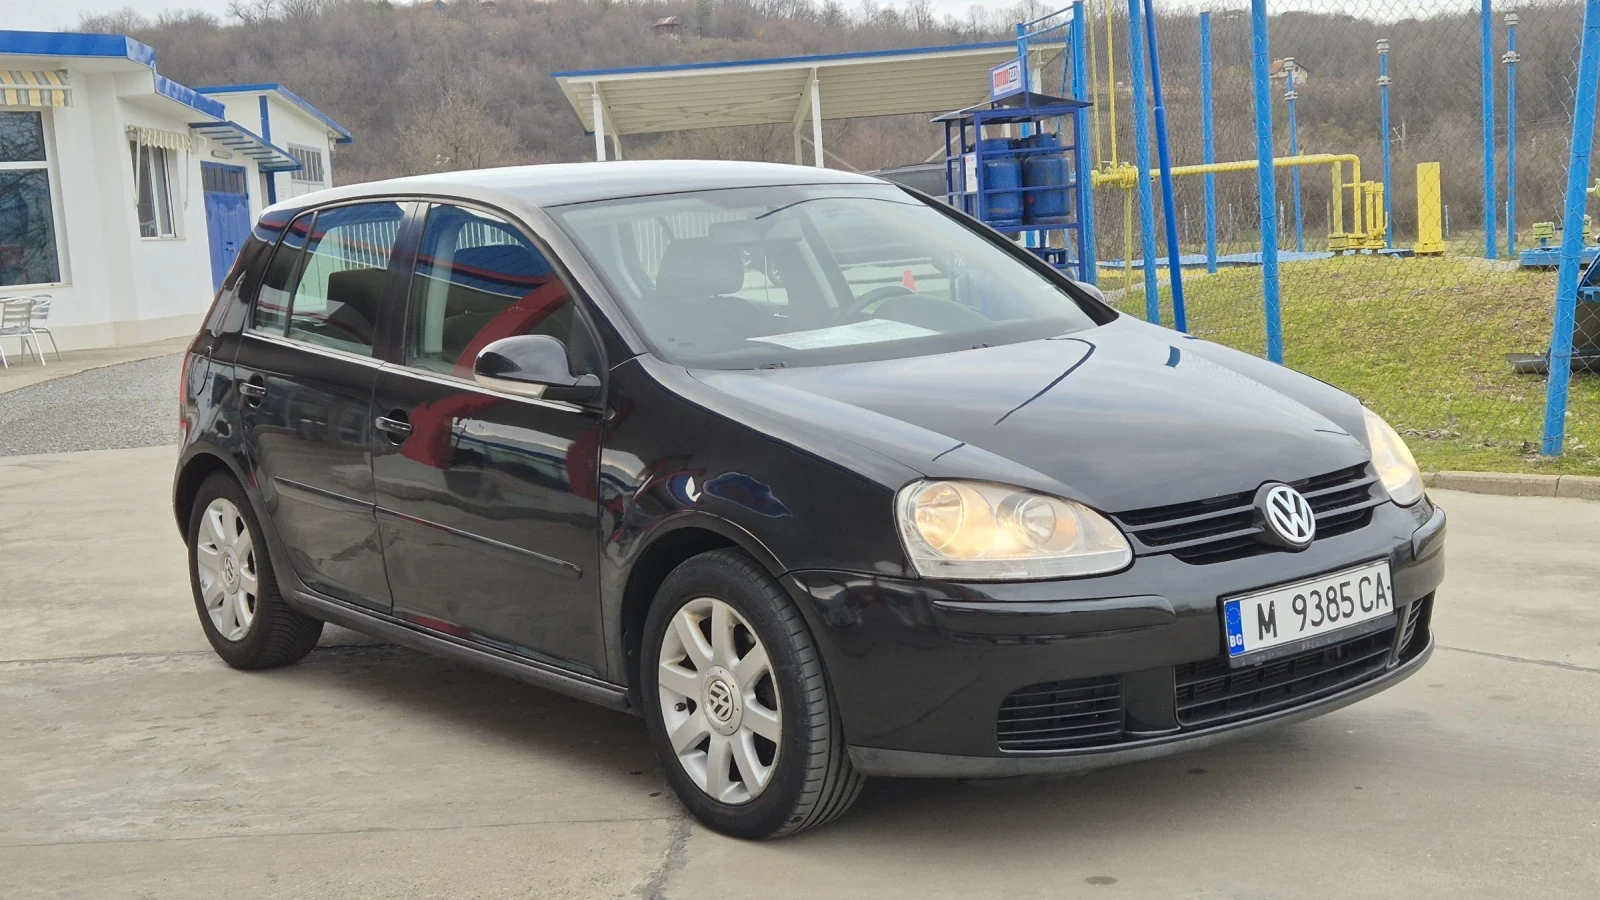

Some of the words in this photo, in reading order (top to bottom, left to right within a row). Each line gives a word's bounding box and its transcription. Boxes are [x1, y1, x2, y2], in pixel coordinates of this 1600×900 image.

[1266, 486, 1316, 543] VW
[1229, 634, 1243, 648] BG
[1257, 600, 1278, 641] M
